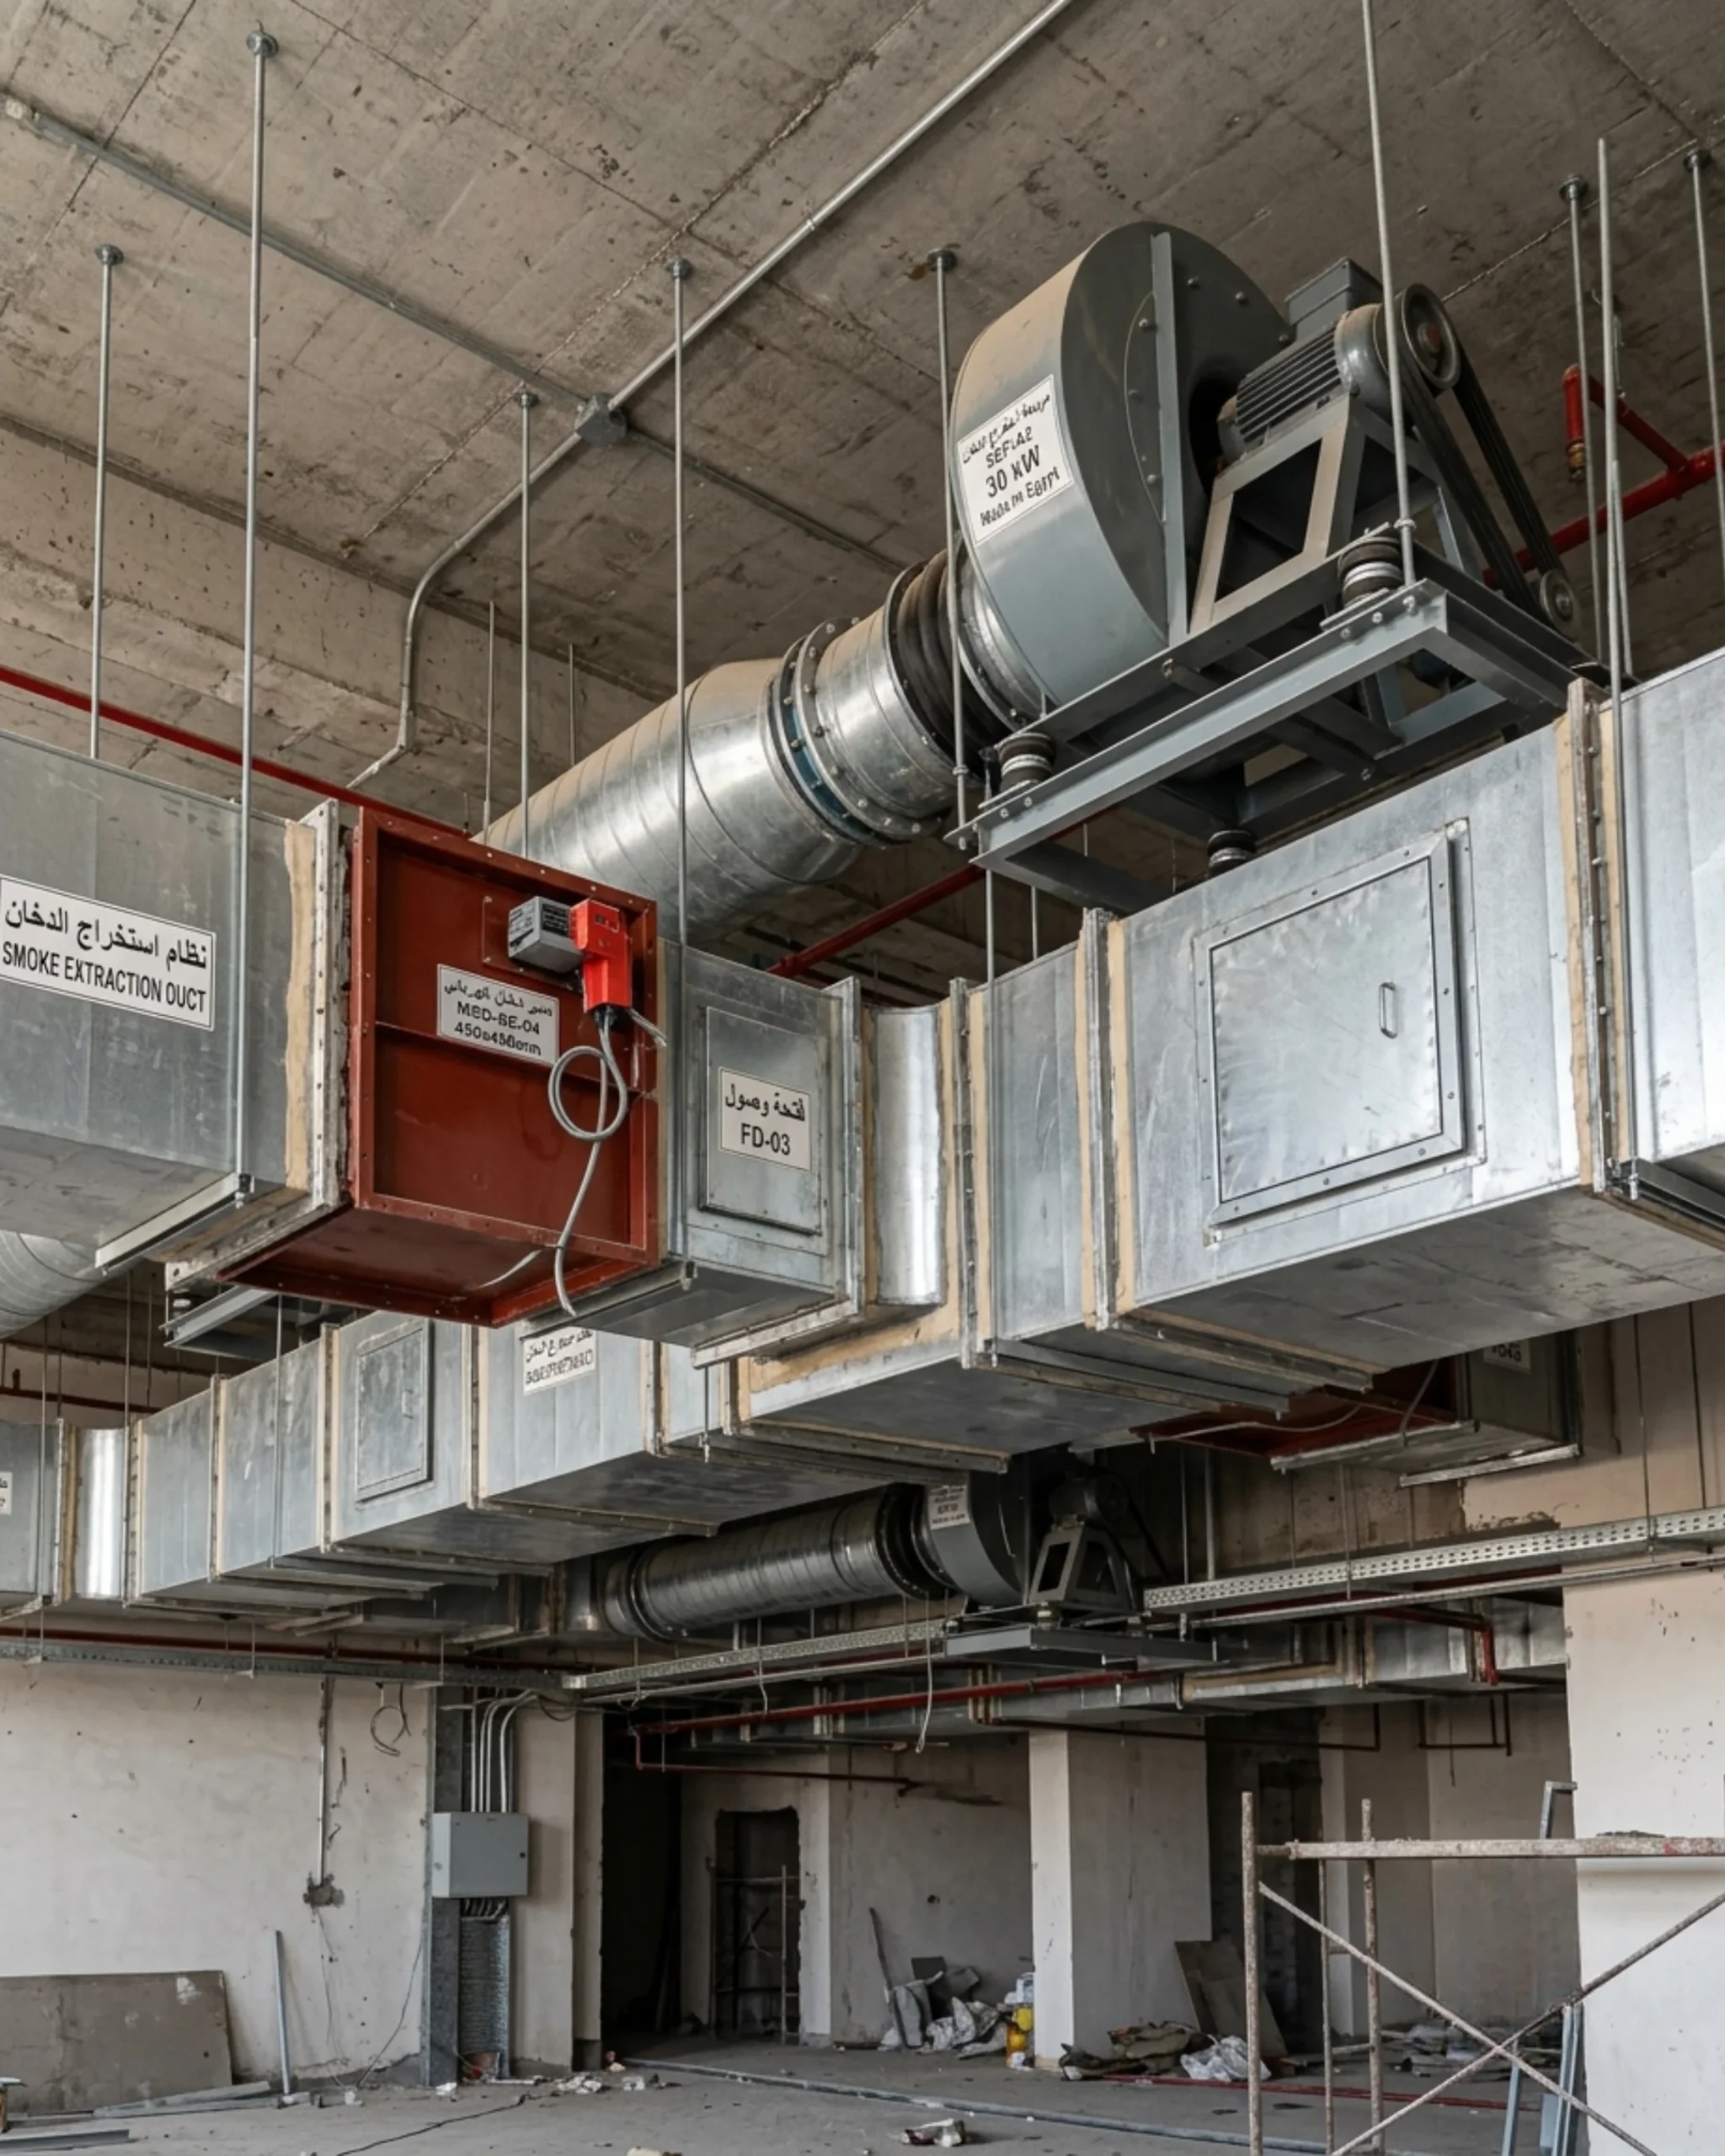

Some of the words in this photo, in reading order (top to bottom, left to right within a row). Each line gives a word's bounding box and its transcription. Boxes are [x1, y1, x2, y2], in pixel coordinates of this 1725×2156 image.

[985, 468, 1007, 499] 30
[5, 899, 69, 934] الدخان
[77, 919, 159, 957] استخراج
[165, 939, 207, 971] نظام
[3, 941, 60, 977] SMOKE
[64, 956, 163, 1002] EXTRACTION
